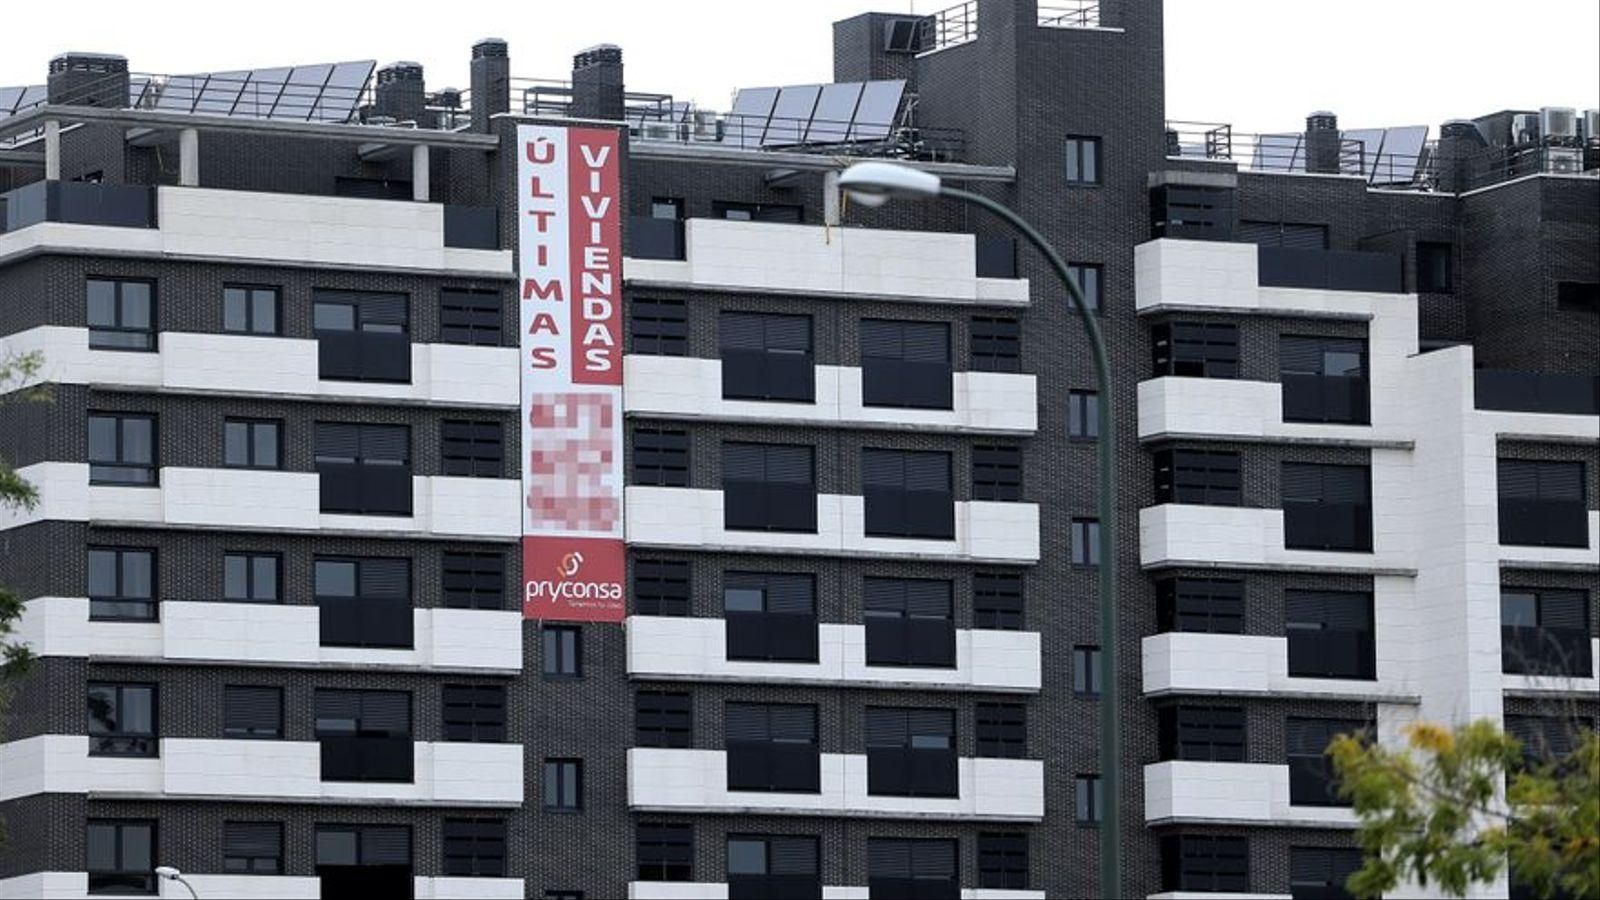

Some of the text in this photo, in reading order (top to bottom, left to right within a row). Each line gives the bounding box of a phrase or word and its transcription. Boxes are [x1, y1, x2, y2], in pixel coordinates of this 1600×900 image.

[523, 137, 563, 369] ÚLTIMAS
[580, 145, 614, 371] VIVIENDAS
[526, 580, 622, 603] pryconsa
